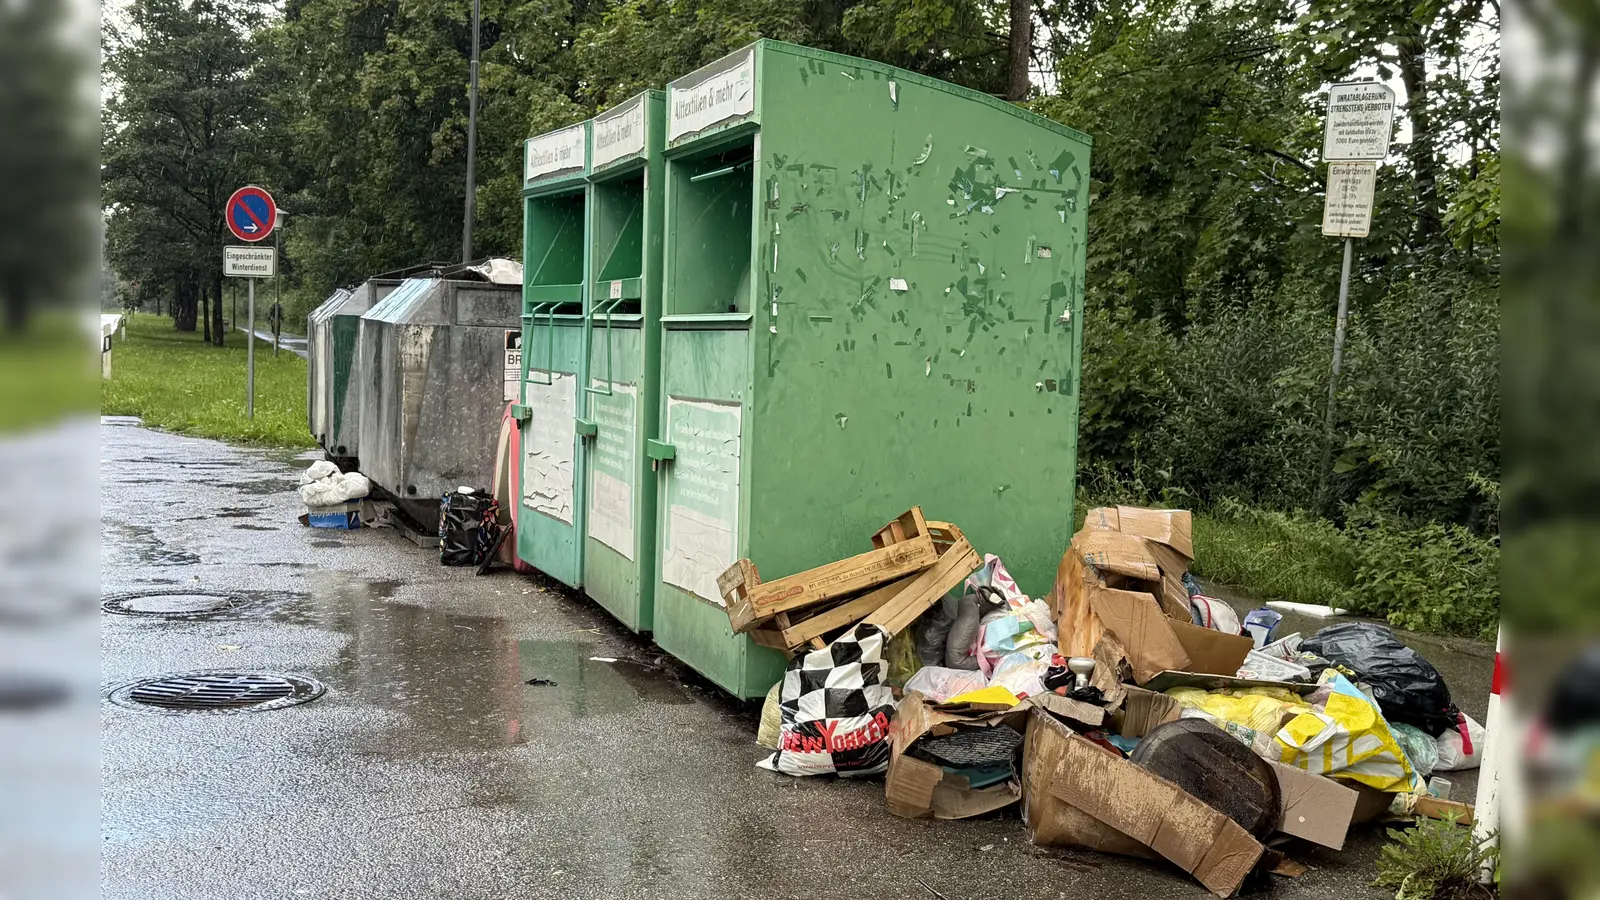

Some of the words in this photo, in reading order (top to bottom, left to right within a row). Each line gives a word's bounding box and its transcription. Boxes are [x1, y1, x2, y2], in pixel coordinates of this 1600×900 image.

[708, 87, 714, 107] &
[716, 80, 734, 105] mehr
[1337, 92, 1387, 102] UNRATABLAGERUNG
[1330, 104, 1363, 113] STRENGSTENS
[1364, 102, 1392, 112] VERBOTEN
[1332, 167, 1371, 175] Einwurfzeiten
[226, 251, 272, 261] Eingeschränkter
[232, 263, 268, 271] Winterdienst
